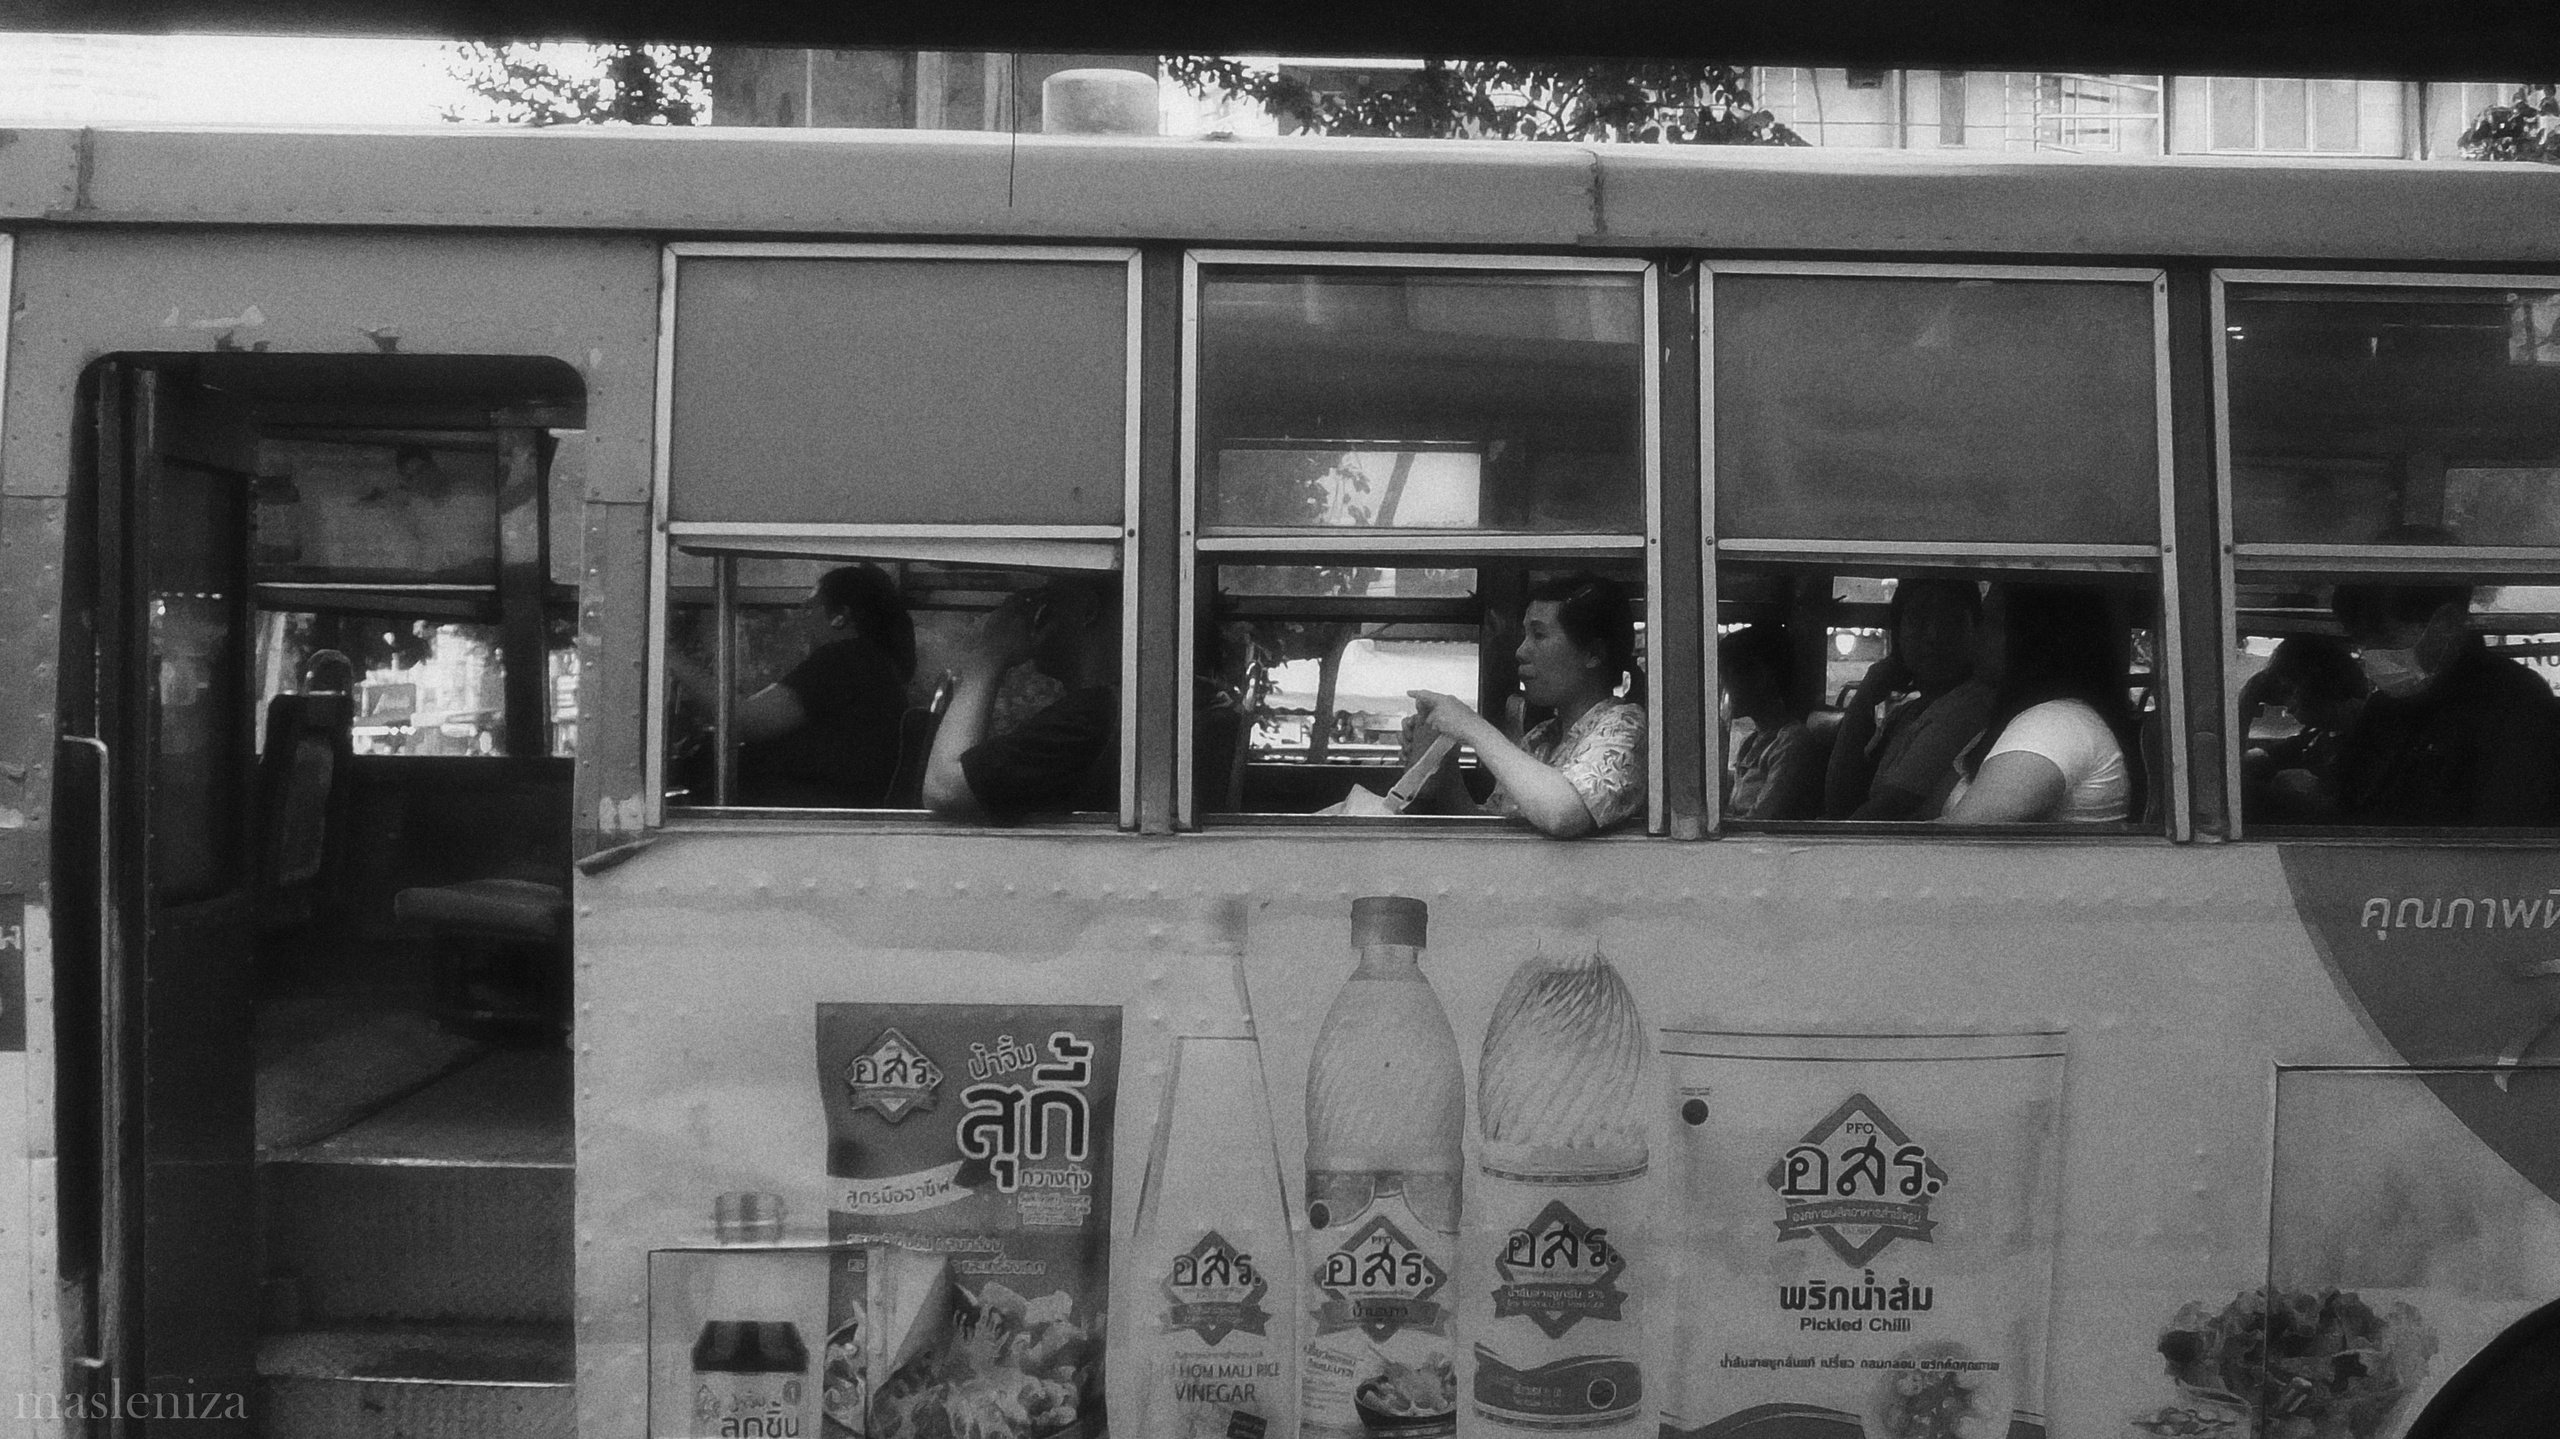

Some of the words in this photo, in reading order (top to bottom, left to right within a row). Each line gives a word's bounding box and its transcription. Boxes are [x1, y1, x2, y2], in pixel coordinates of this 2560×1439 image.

[957, 1031, 1095, 1193] สุกี้
[1781, 1135, 1940, 1197] อสร.
[1324, 1246, 1434, 1287] อสร.
[1780, 1268, 1933, 1311] พริกน้ำส้ม
[1800, 1317, 1862, 1332] Pickled
[1869, 1317, 1911, 1332] Chilli
[1175, 1383, 1256, 1403] VINEGAR
